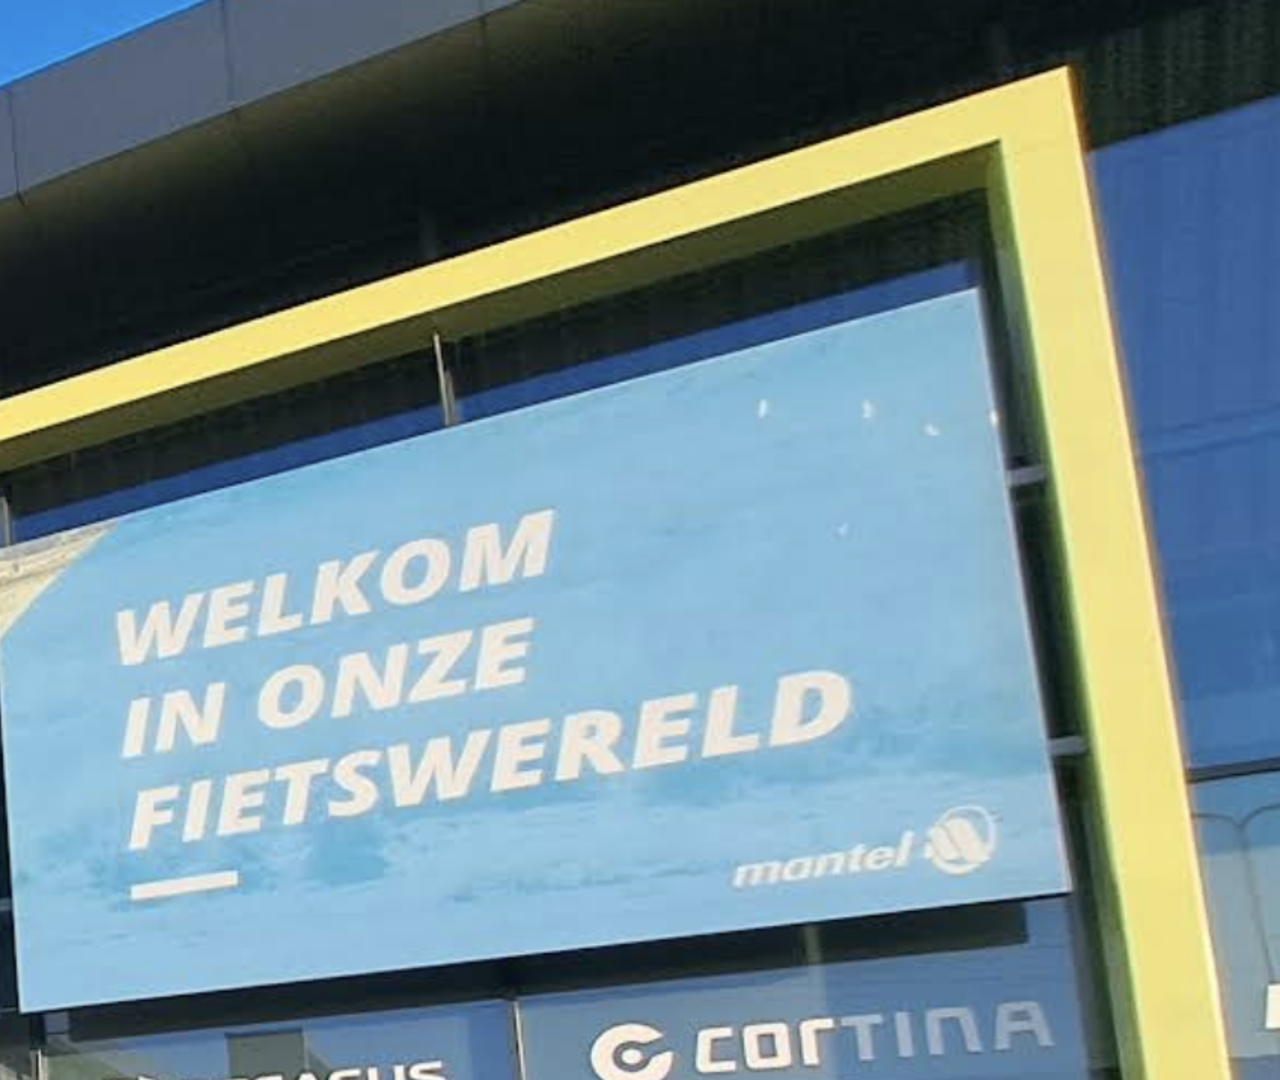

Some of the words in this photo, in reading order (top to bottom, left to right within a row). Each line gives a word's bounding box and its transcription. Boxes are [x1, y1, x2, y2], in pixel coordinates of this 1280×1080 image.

[115, 509, 556, 666] WELKOM
[121, 683, 225, 758] IN
[256, 618, 534, 730] ONZE
[128, 670, 852, 851] FIETSWERELD
[732, 829, 914, 889] mantel
